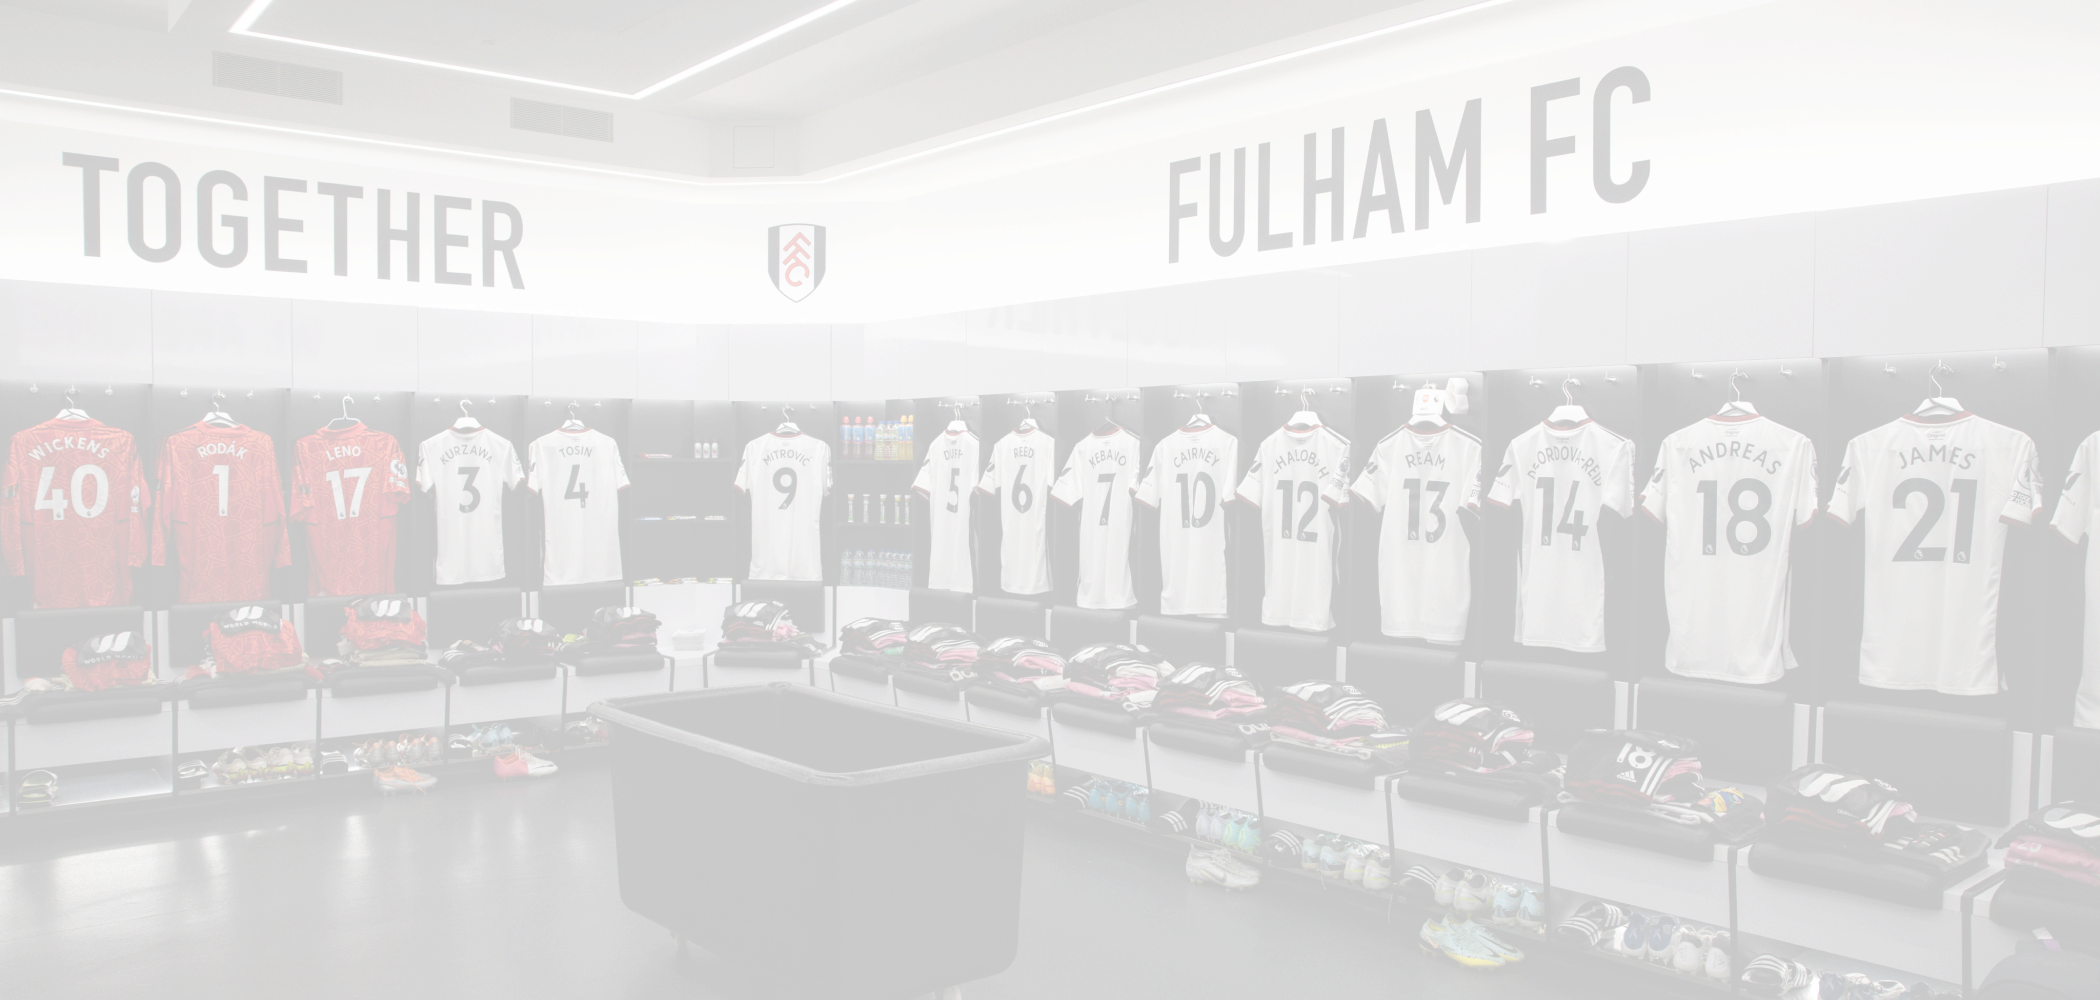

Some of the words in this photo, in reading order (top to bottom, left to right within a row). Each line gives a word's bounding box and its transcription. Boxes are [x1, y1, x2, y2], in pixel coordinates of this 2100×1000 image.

[1168, 97, 1482, 264] FULHAM
[1530, 65, 1652, 216] FC
[62, 151, 526, 290] TOGETHER
[782, 231, 812, 287] FFC
[28, 437, 111, 461] WICKENS
[197, 440, 248, 460] RODÁK
[325, 445, 361, 461] LENO
[439, 444, 493, 466] KURZAWA
[559, 445, 592, 459] TOSIN
[763, 449, 813, 467] MITROVIĆ
[1013, 446, 1034, 459] REED
[1088, 449, 1127, 469] KEBANO
[1173, 447, 1221, 468] CAIRNEY
[1404, 451, 1446, 471] REAM
[1537, 445, 1602, 487] ORDOVA-REID
[1688, 440, 1782, 475] ANDREAS
[1898, 444, 1977, 470] JAMES
[34, 464, 109, 521] 40
[212, 465, 230, 517] 1
[325, 466, 372, 520] 17
[457, 466, 480, 514] 3
[564, 464, 589, 508] 4
[772, 467, 798, 510] 9
[946, 467, 960, 513] 5
[1011, 464, 1033, 514] 6
[1097, 472, 1117, 526] 7
[1175, 471, 1216, 528] 10
[1276, 479, 1319, 543] 12
[1402, 478, 1451, 544] 13
[1535, 476, 1590, 552] 14
[1696, 477, 1773, 556] 18
[1891, 477, 1978, 565] 21
[222, 621, 250, 630] WORLD
[83, 655, 112, 665] WORLD
[1616, 742, 1658, 769] 18
